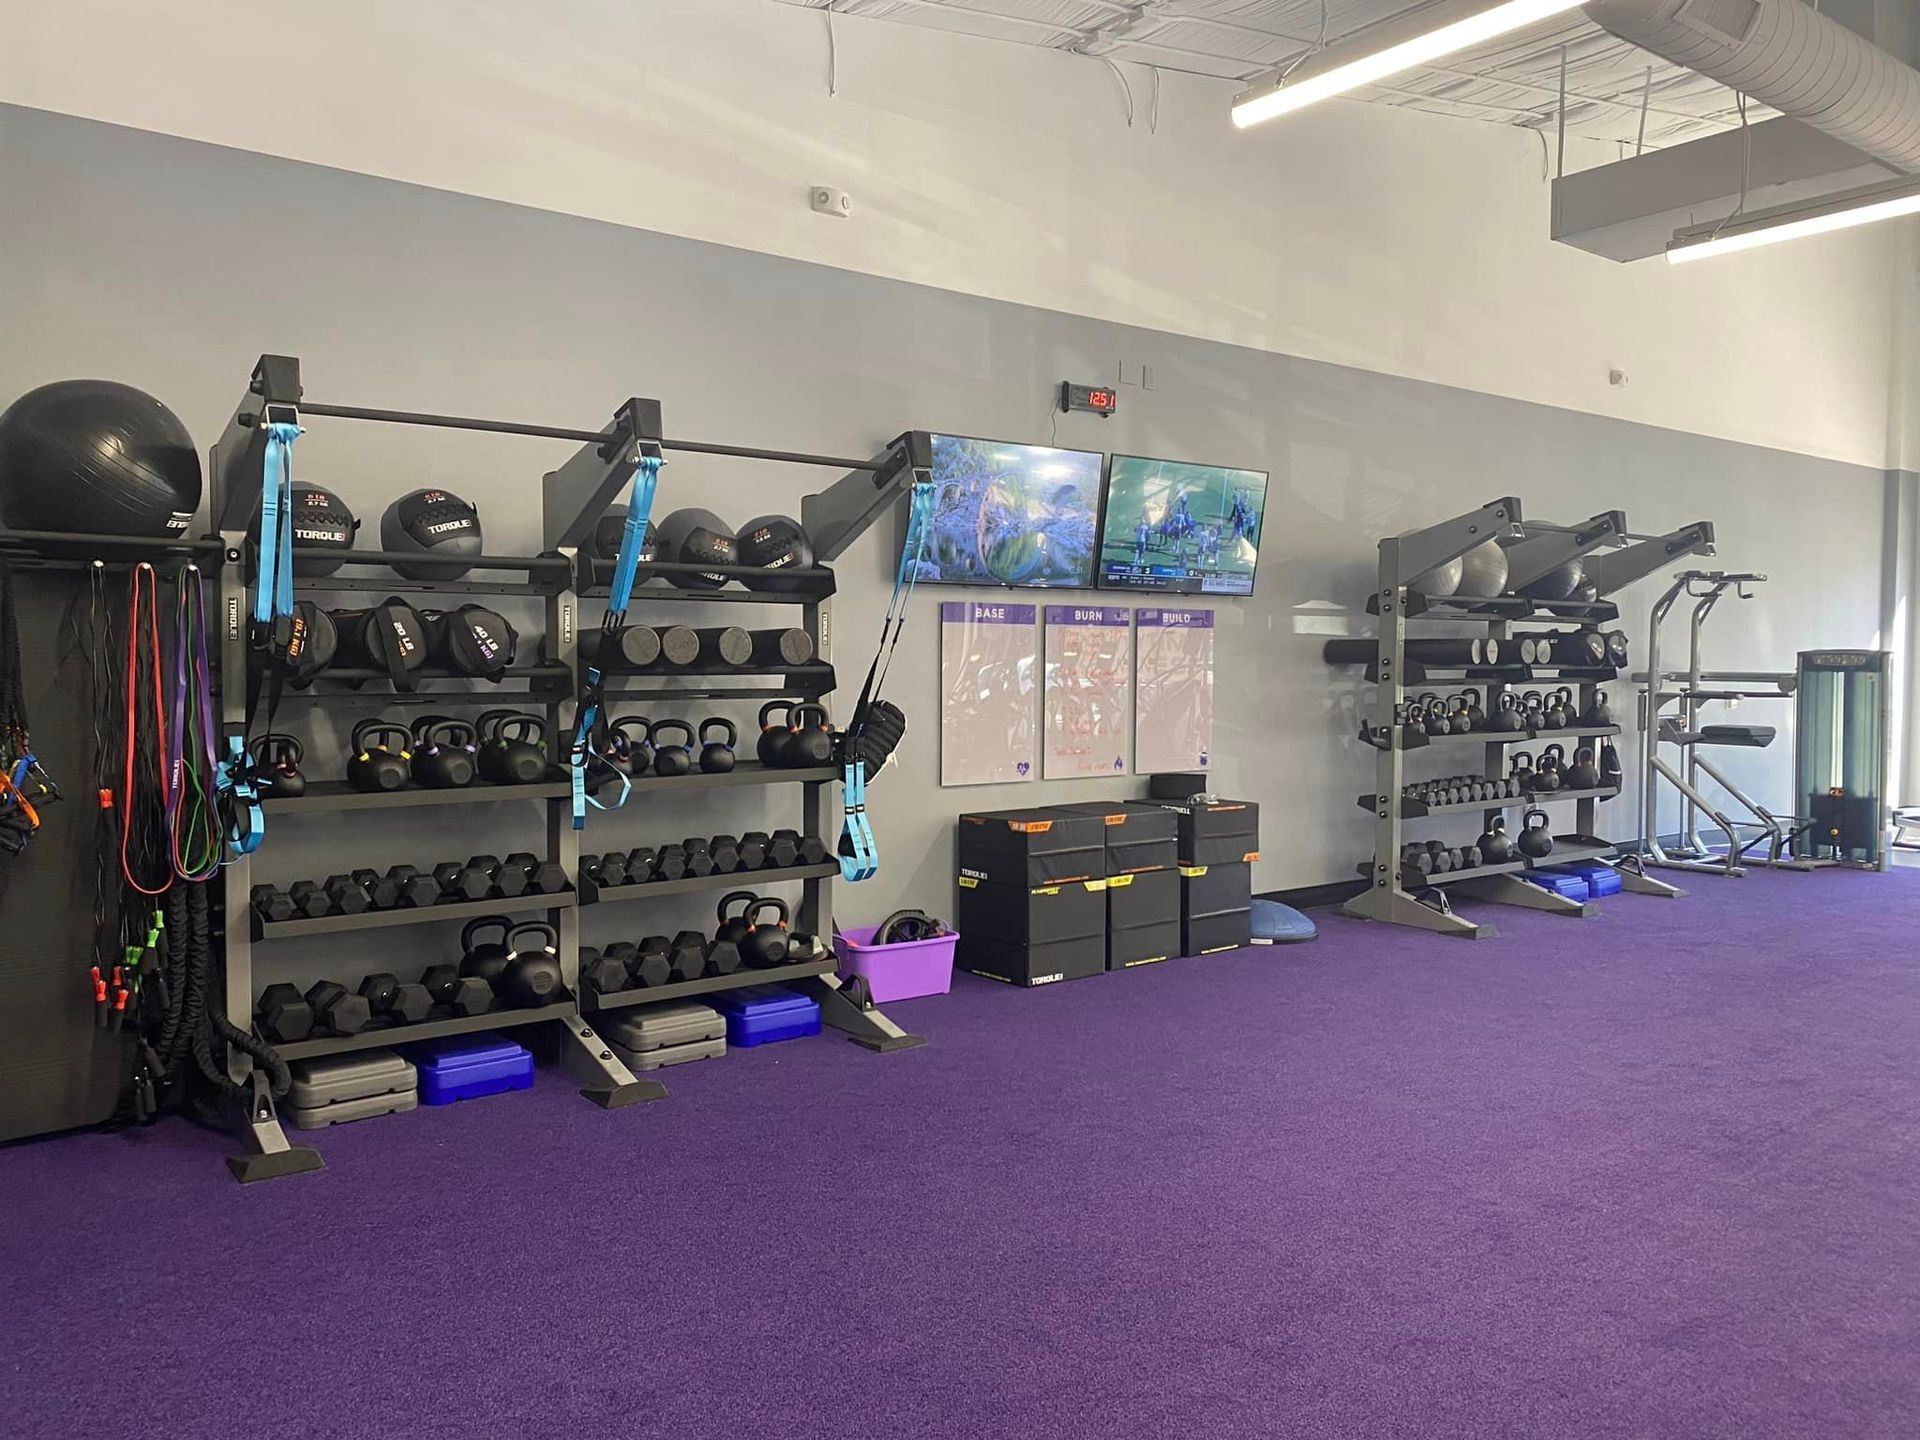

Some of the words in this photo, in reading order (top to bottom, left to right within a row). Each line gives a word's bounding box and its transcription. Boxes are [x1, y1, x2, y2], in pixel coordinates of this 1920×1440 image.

[427, 519, 472, 534] TORQUE
[295, 528, 346, 541] TORQUE
[229, 598, 238, 640] TORQUE
[975, 607, 1005, 619] BASE
[1074, 609, 1103, 621] BURN
[1162, 612, 1191, 624] BUILD
[393, 621, 406, 636] 20
[474, 625, 488, 639] 40
[485, 638, 499, 651] LB
[1031, 973, 1064, 985] TORQUE
